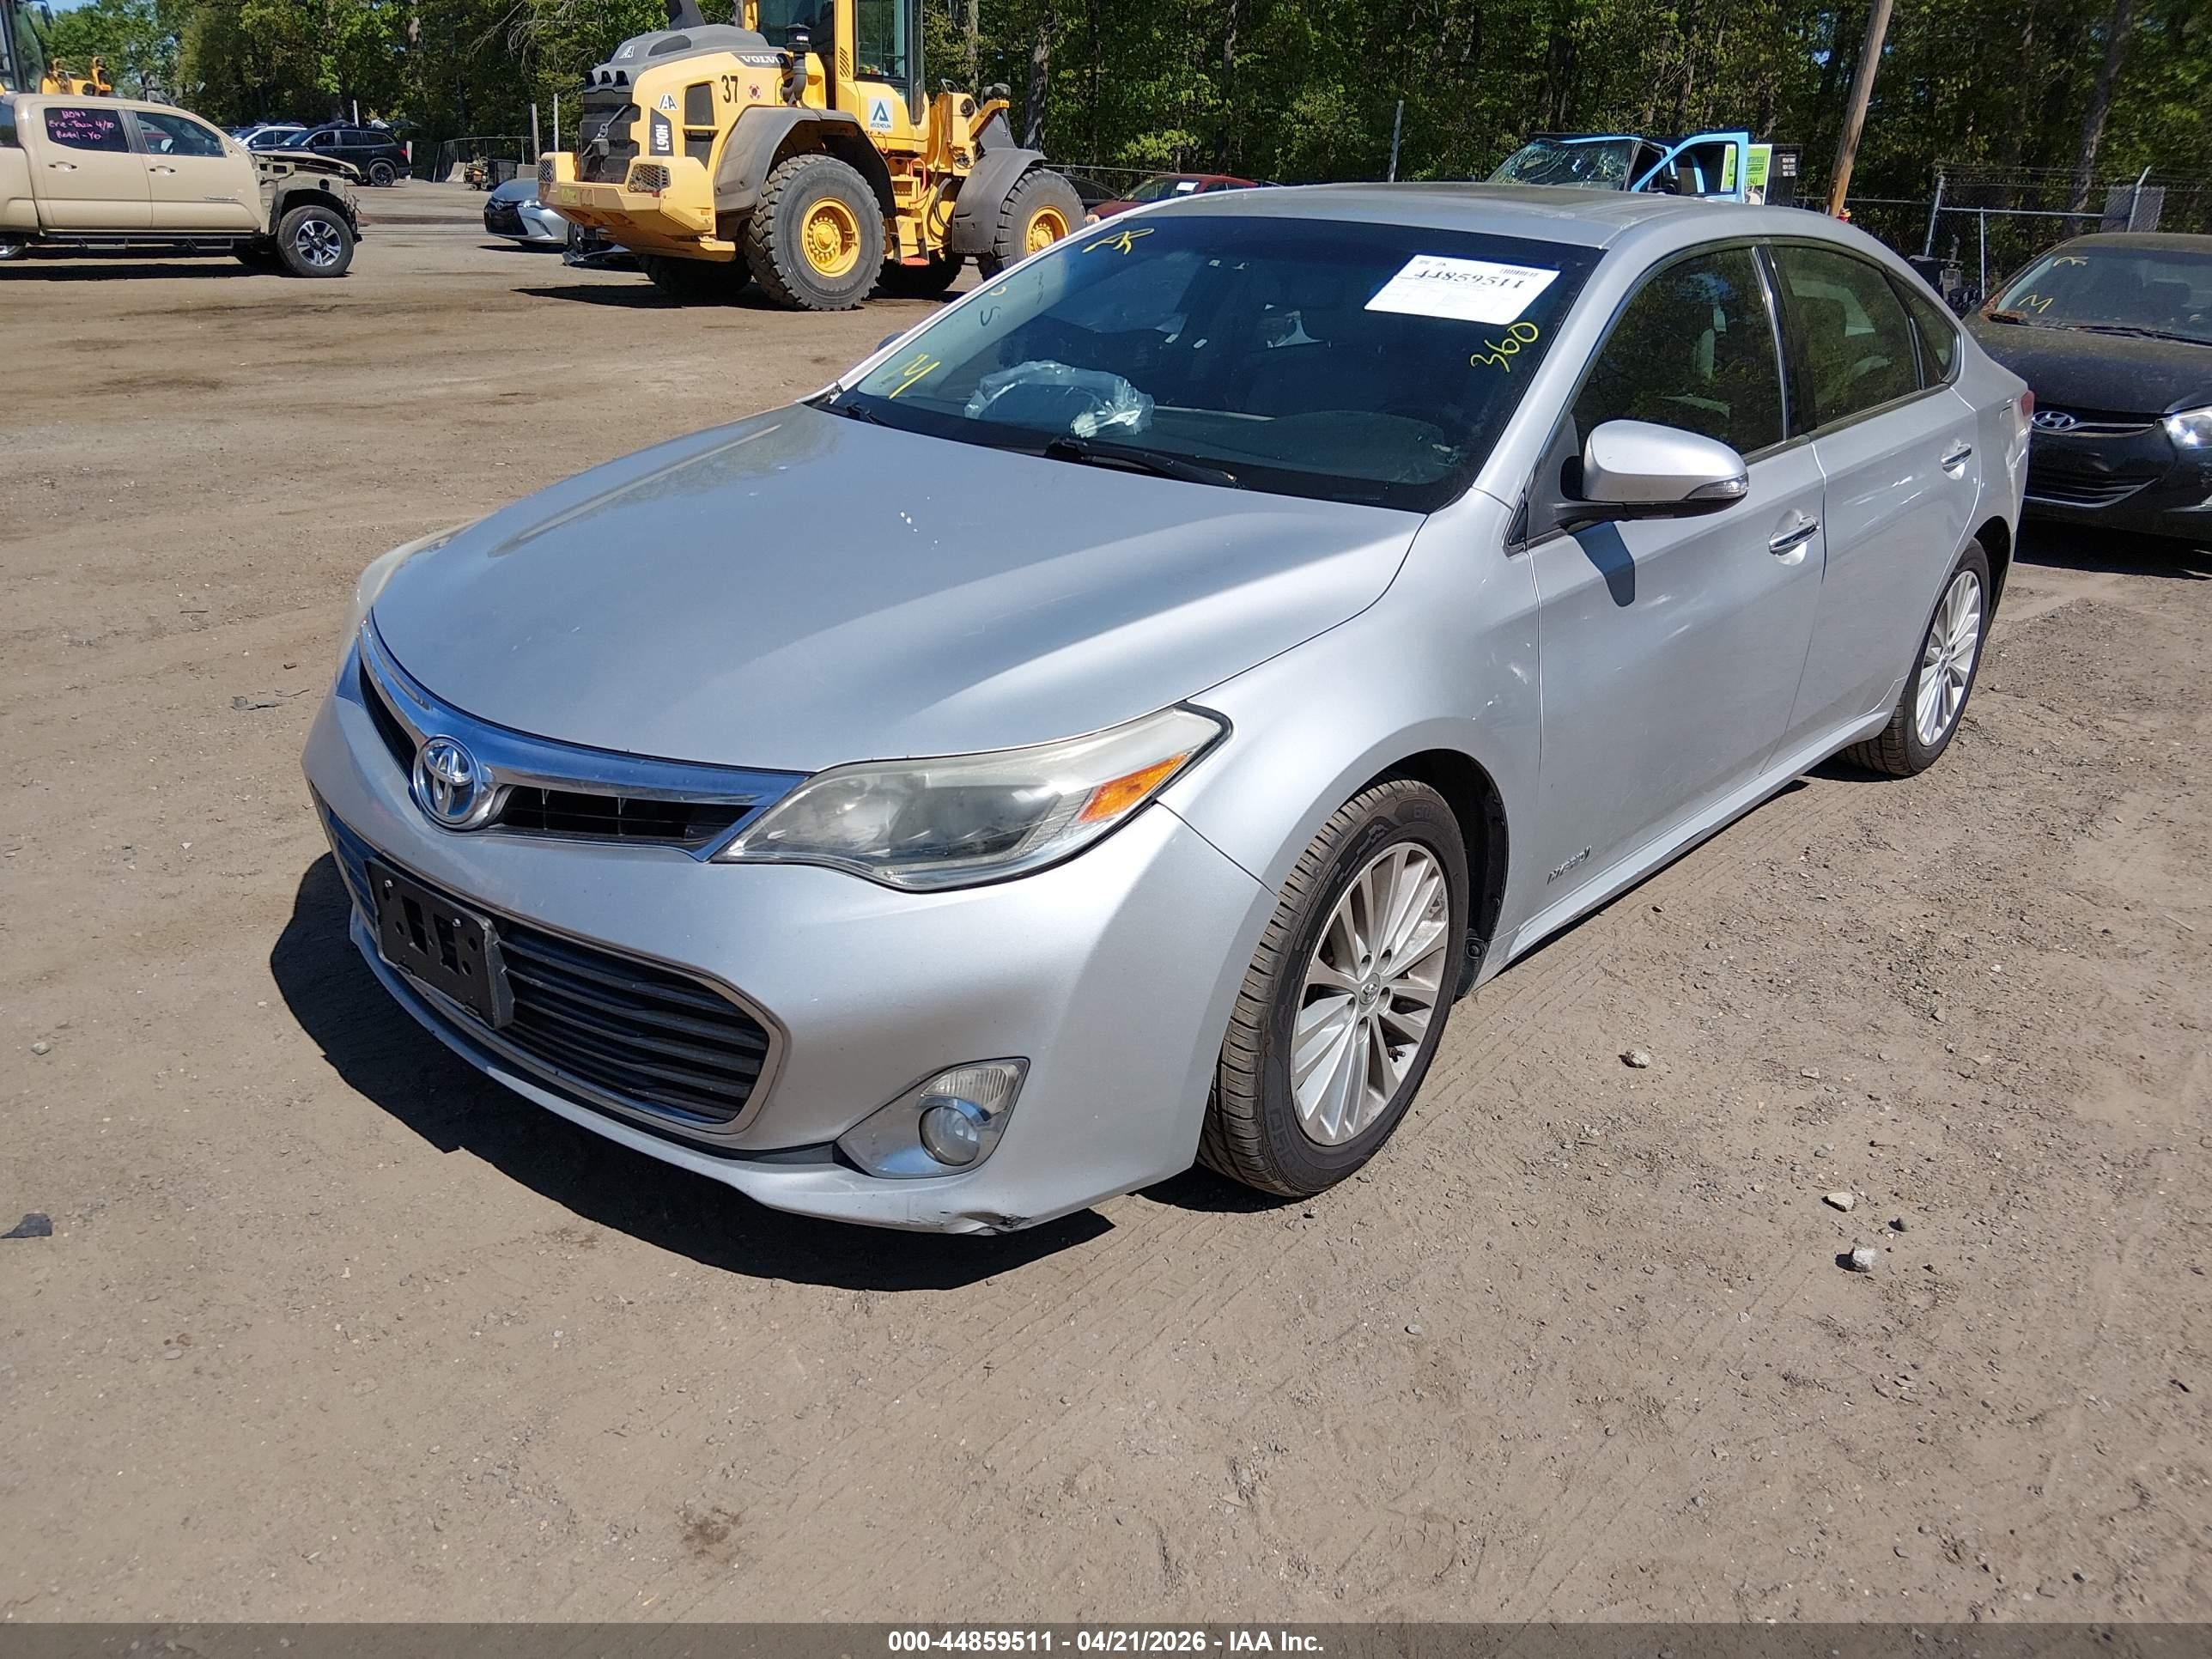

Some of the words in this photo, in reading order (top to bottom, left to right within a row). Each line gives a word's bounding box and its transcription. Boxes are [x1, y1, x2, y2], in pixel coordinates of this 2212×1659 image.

[741, 55, 784, 64] VOLVO
[721, 75, 738, 104] 37
[654, 124, 670, 151] L90H
[1414, 270, 1525, 289] 44859511
[1470, 322, 1539, 373] 360
